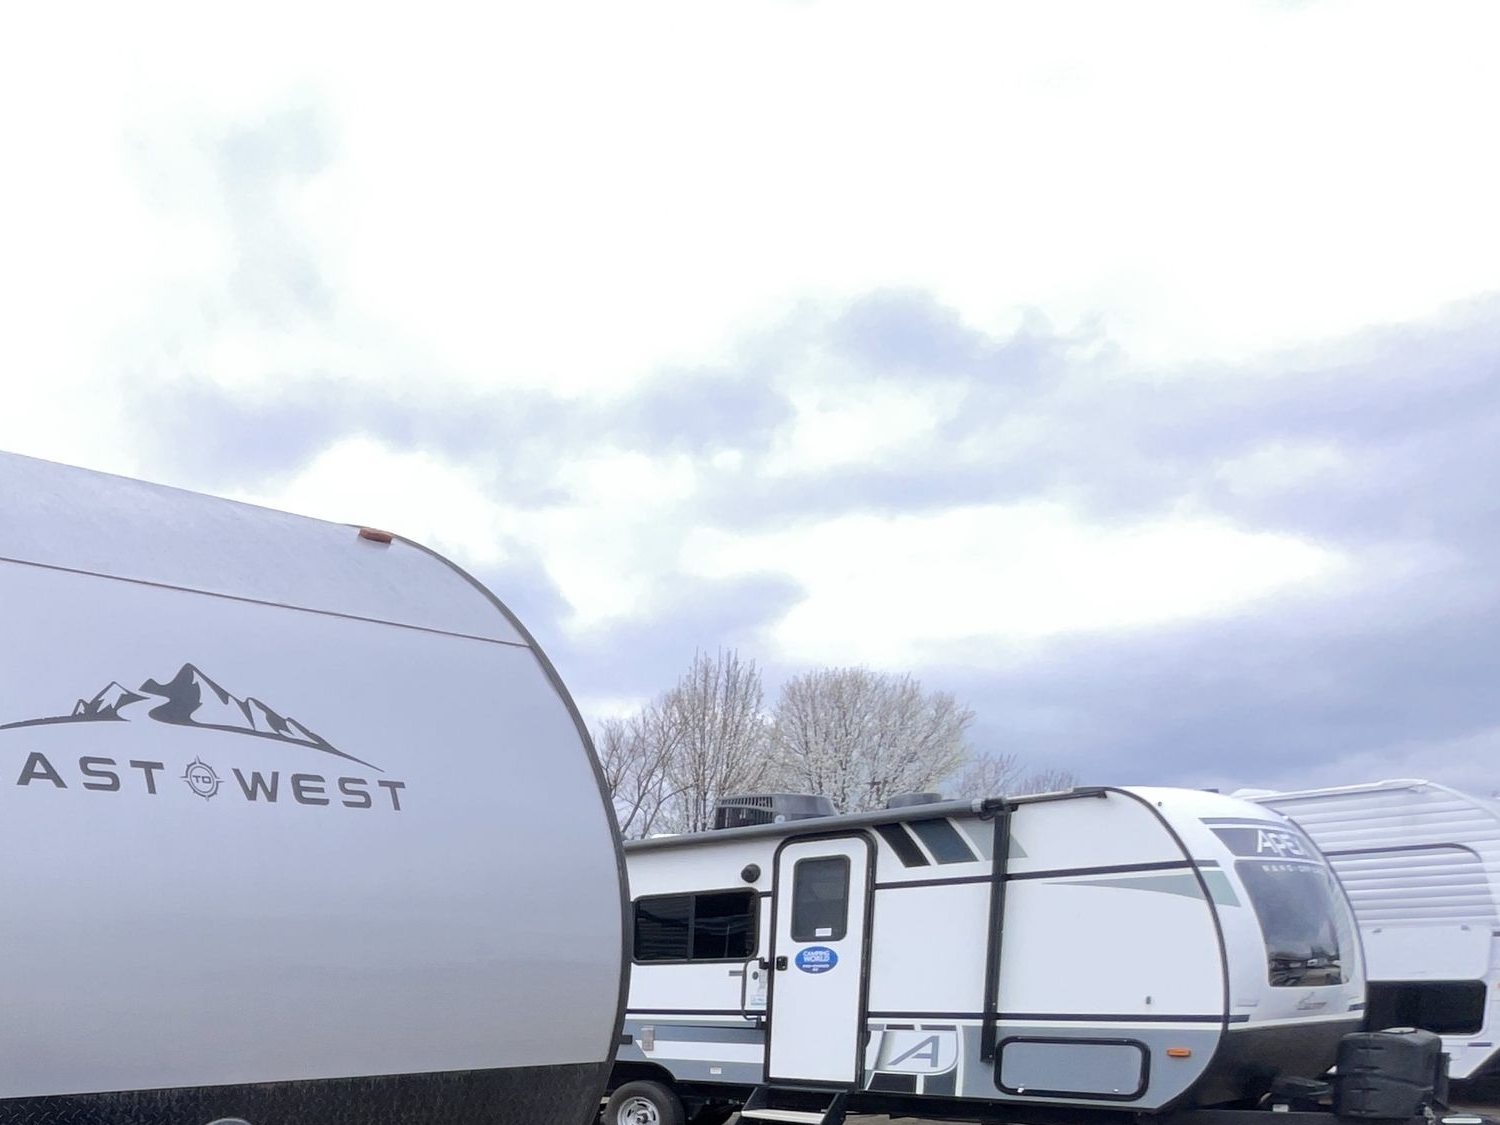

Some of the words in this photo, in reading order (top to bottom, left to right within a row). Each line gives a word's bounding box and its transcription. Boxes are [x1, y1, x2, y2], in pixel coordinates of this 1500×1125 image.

[192, 775, 212, 784] TO
[231, 767, 406, 812] WEST
[803, 955, 830, 963] WORLD
